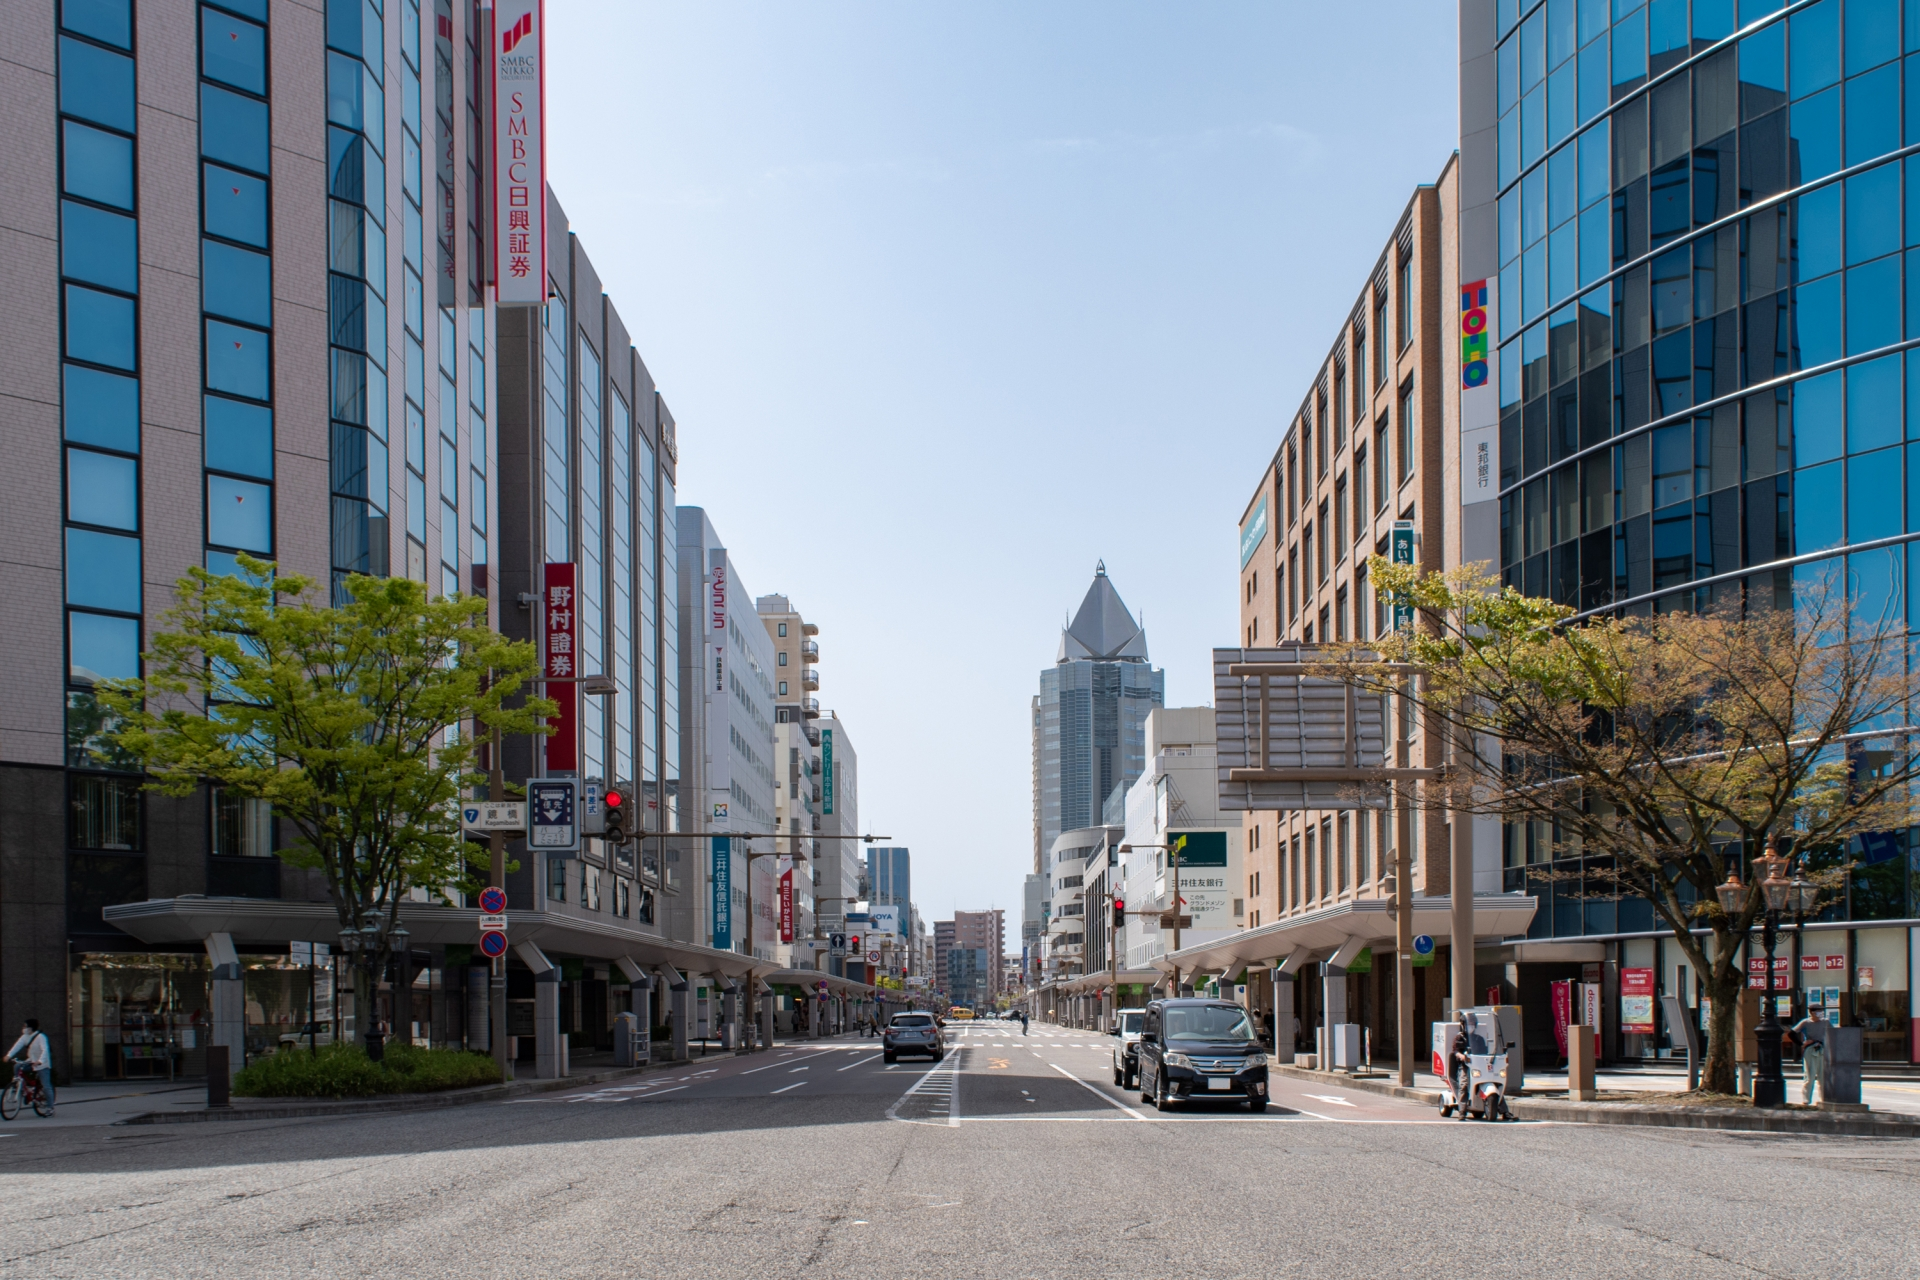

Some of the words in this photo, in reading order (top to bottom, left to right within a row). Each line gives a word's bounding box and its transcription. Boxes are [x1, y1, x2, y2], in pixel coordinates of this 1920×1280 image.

[501, 56, 534, 66] SMBC
[501, 67, 534, 75] NIKKO
[508, 91, 531, 278] SMBC日興証券
[1461, 278, 1488, 391] TOHO
[1477, 442, 1489, 488] 東邦銀行
[549, 585, 572, 677] 野村證券
[824, 743, 832, 810] カントリーホテル新潟
[468, 810, 475, 821] 7
[542, 800, 563, 809] 優先
[587, 786, 597, 814] 時差式
[485, 819, 520, 827] Kagamibashi
[715, 850, 727, 933] 三井住友信託銀行
[782, 880, 791, 935] 岡三にいがた証券
[1826, 958, 1843, 967] e12
